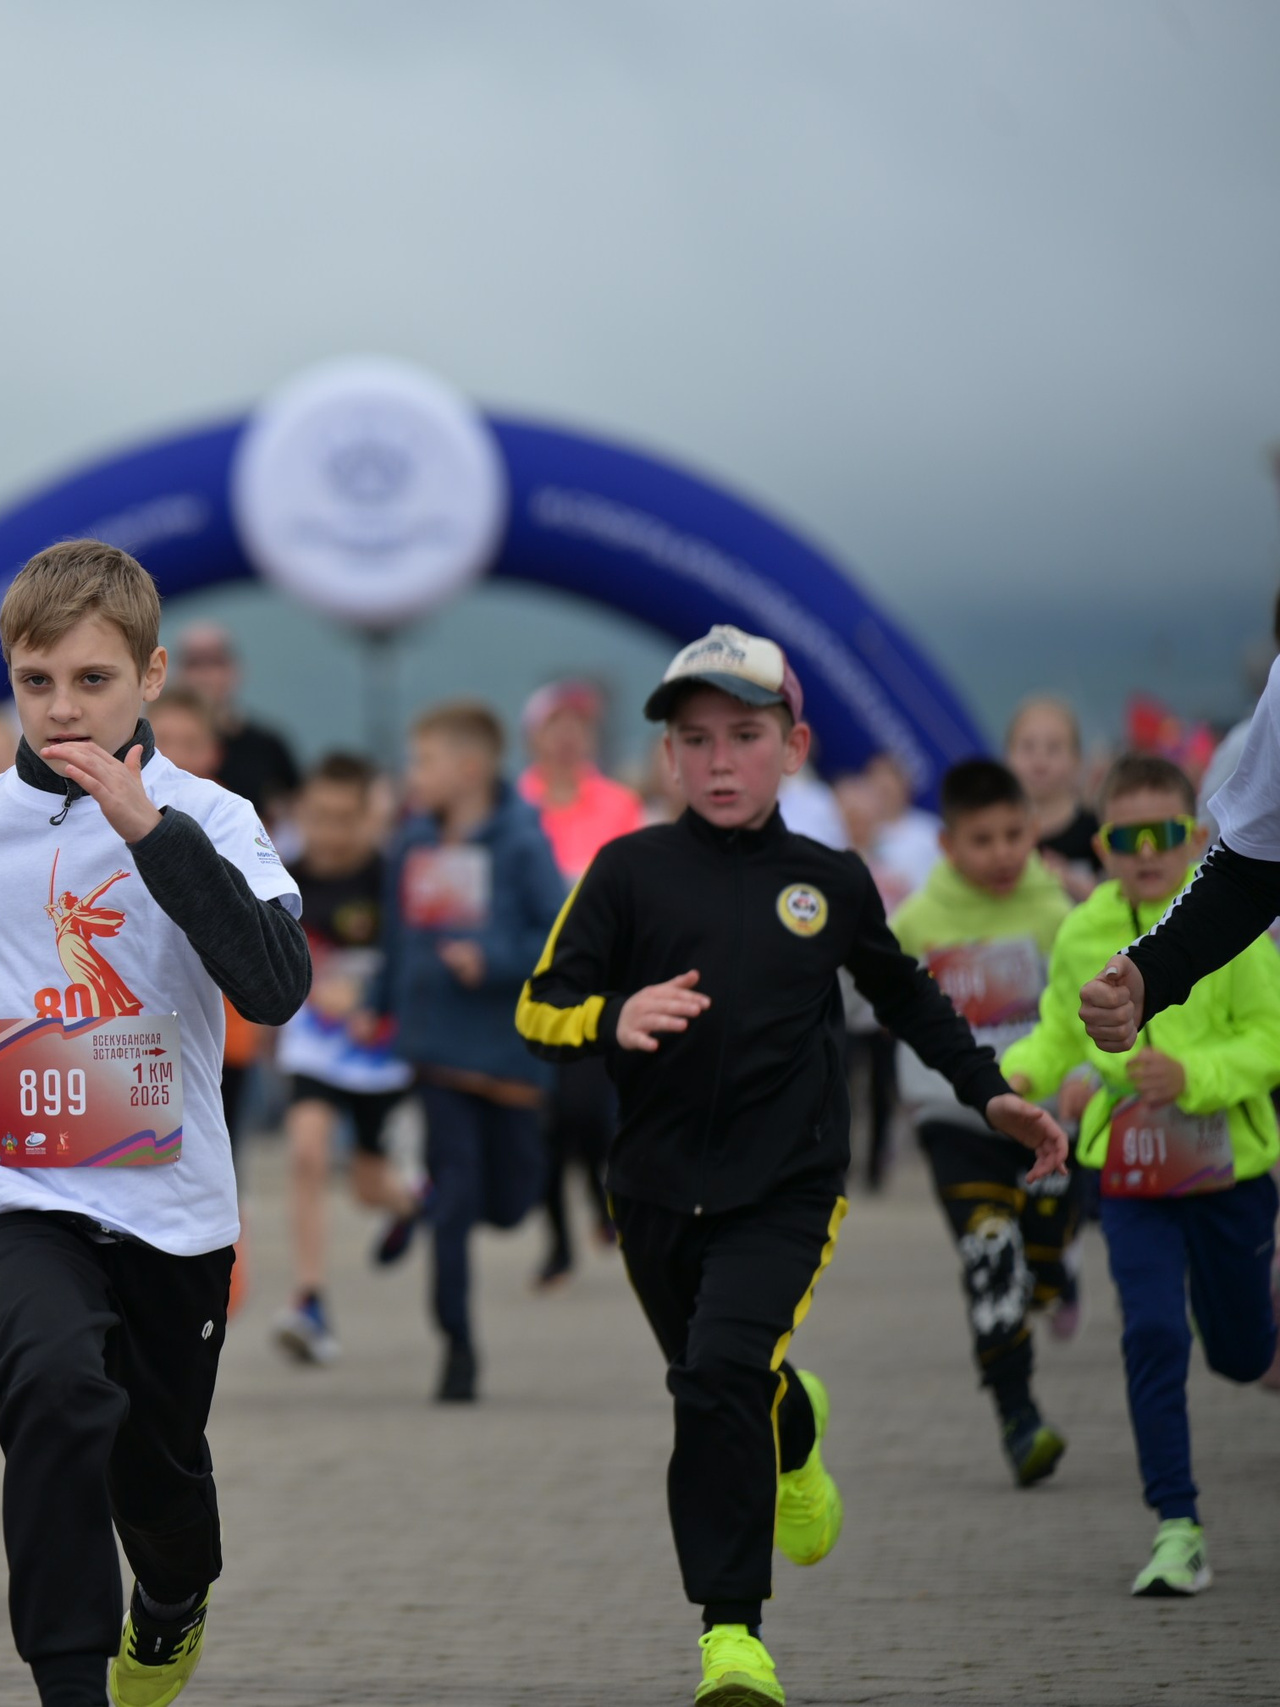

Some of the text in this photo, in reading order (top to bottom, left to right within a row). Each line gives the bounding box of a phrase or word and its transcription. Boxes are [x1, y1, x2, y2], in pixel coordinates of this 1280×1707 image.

[92, 1033, 161, 1047] ВСЕКУБАНСКАЯ
[93, 1047, 141, 1060] ЭСТАФЕТА
[132, 1062, 173, 1083] 1 КМ
[20, 1069, 86, 1116] 899
[130, 1085, 169, 1106] 2025
